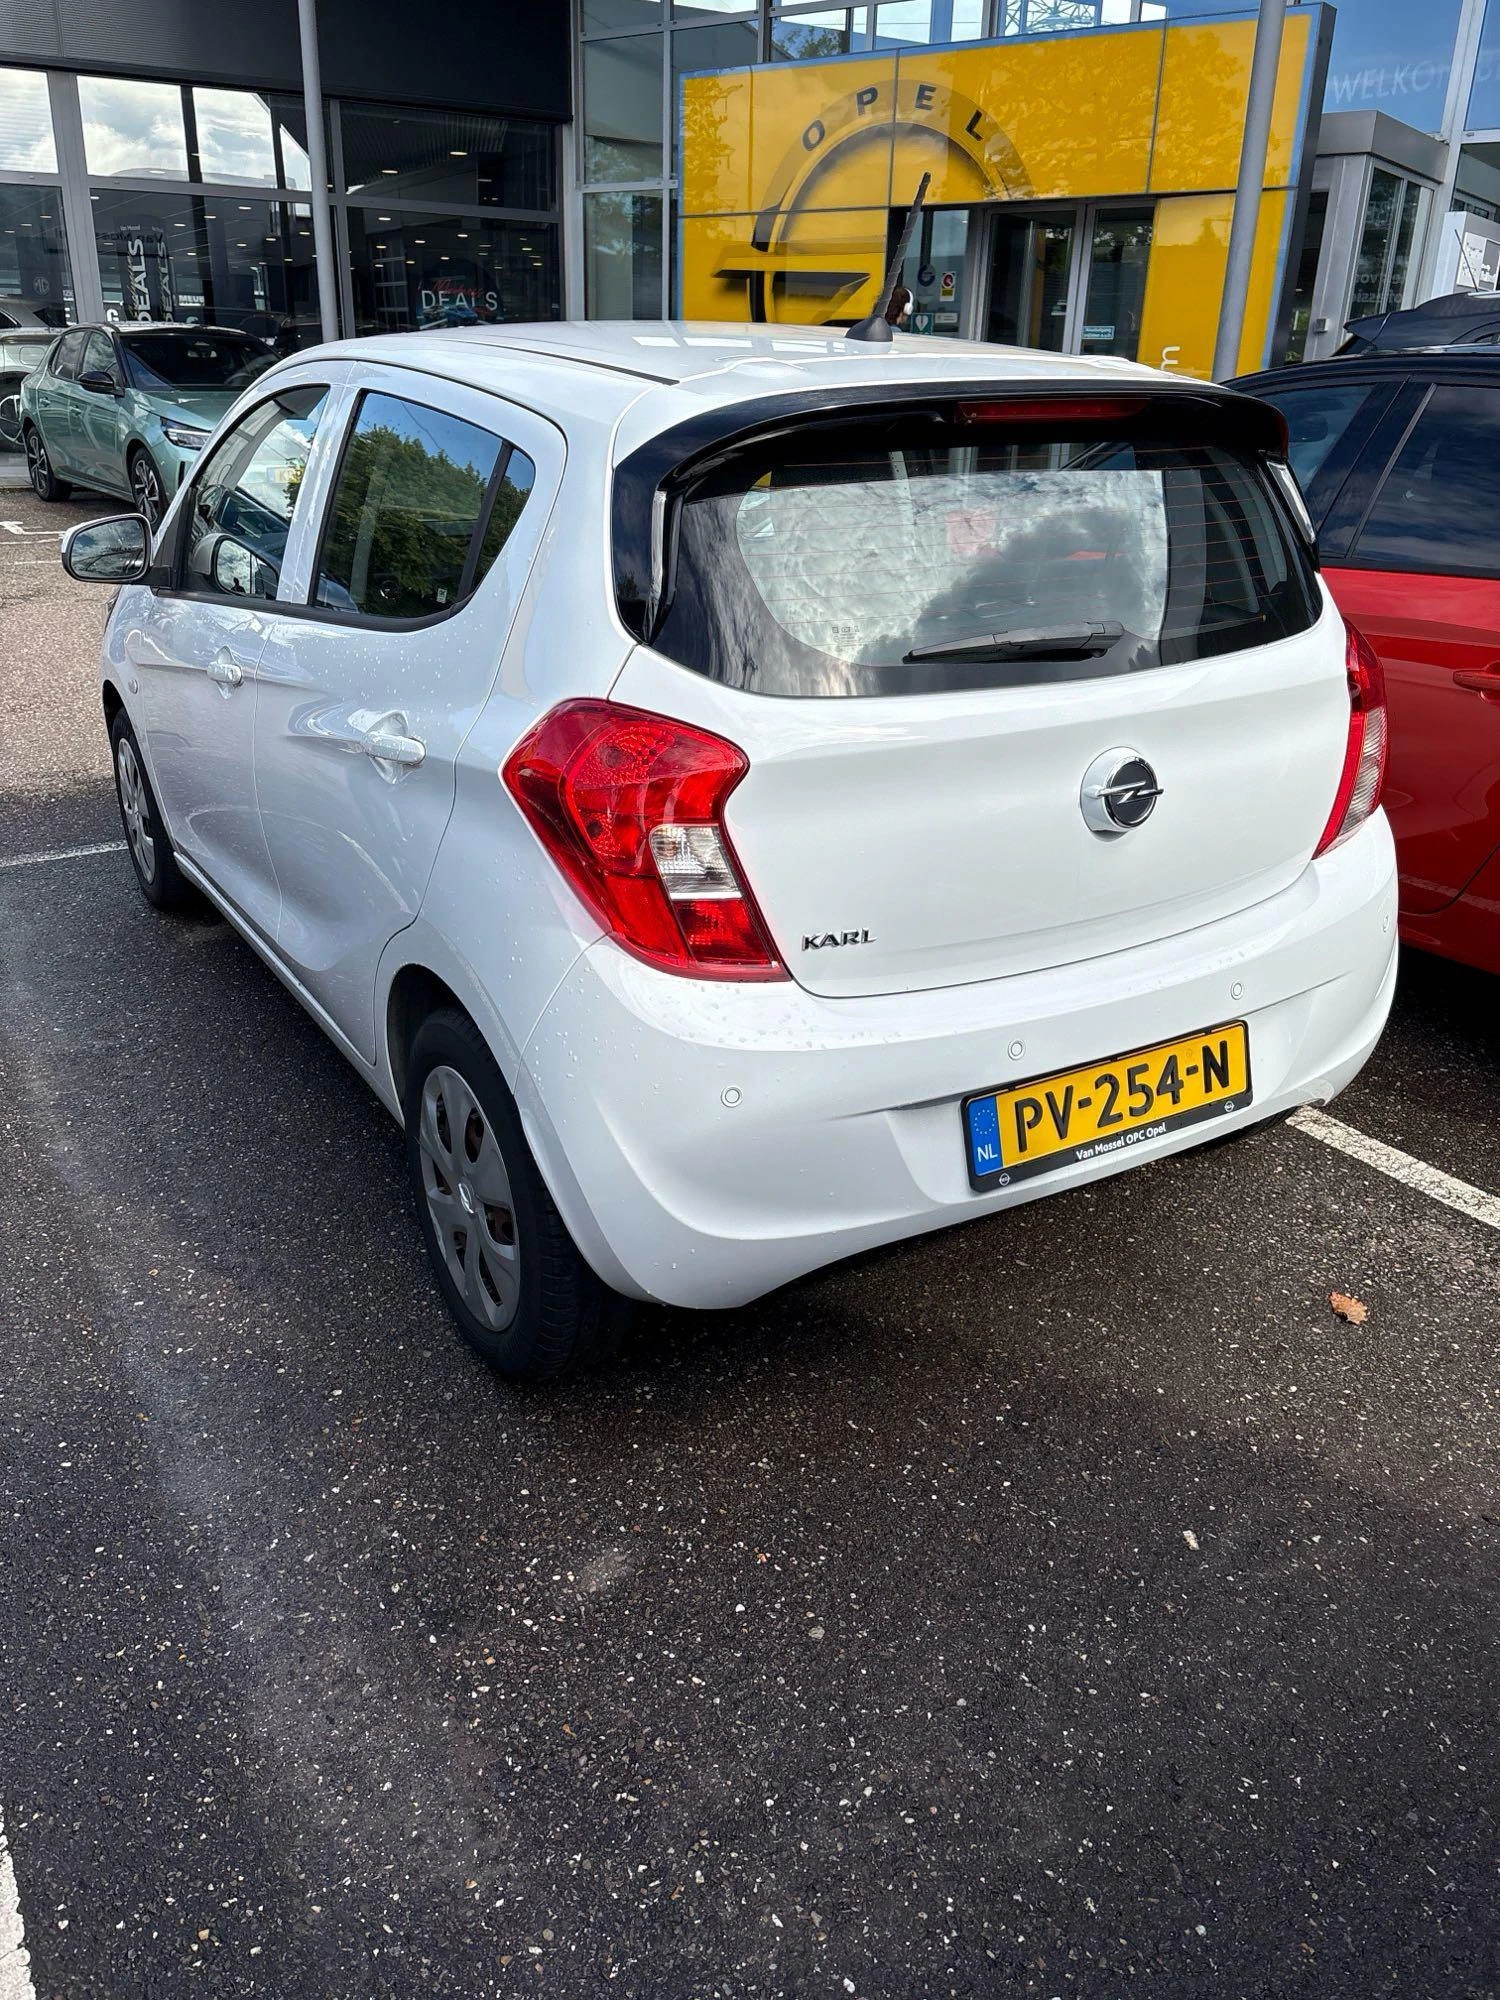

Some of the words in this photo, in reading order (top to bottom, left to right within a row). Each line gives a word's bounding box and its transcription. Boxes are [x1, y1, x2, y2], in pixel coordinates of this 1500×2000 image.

[802, 84, 985, 152] OPEL
[421, 290, 498, 311] DEALS
[801, 927, 879, 951] KARL
[1014, 1040, 1230, 1153] PV-254-N
[977, 1143, 998, 1162] NL
[1076, 1149, 1094, 1160] Van
[1095, 1136, 1125, 1155] Mossel
[1126, 1130, 1145, 1145] OPC
[1146, 1121, 1167, 1138] Opel
